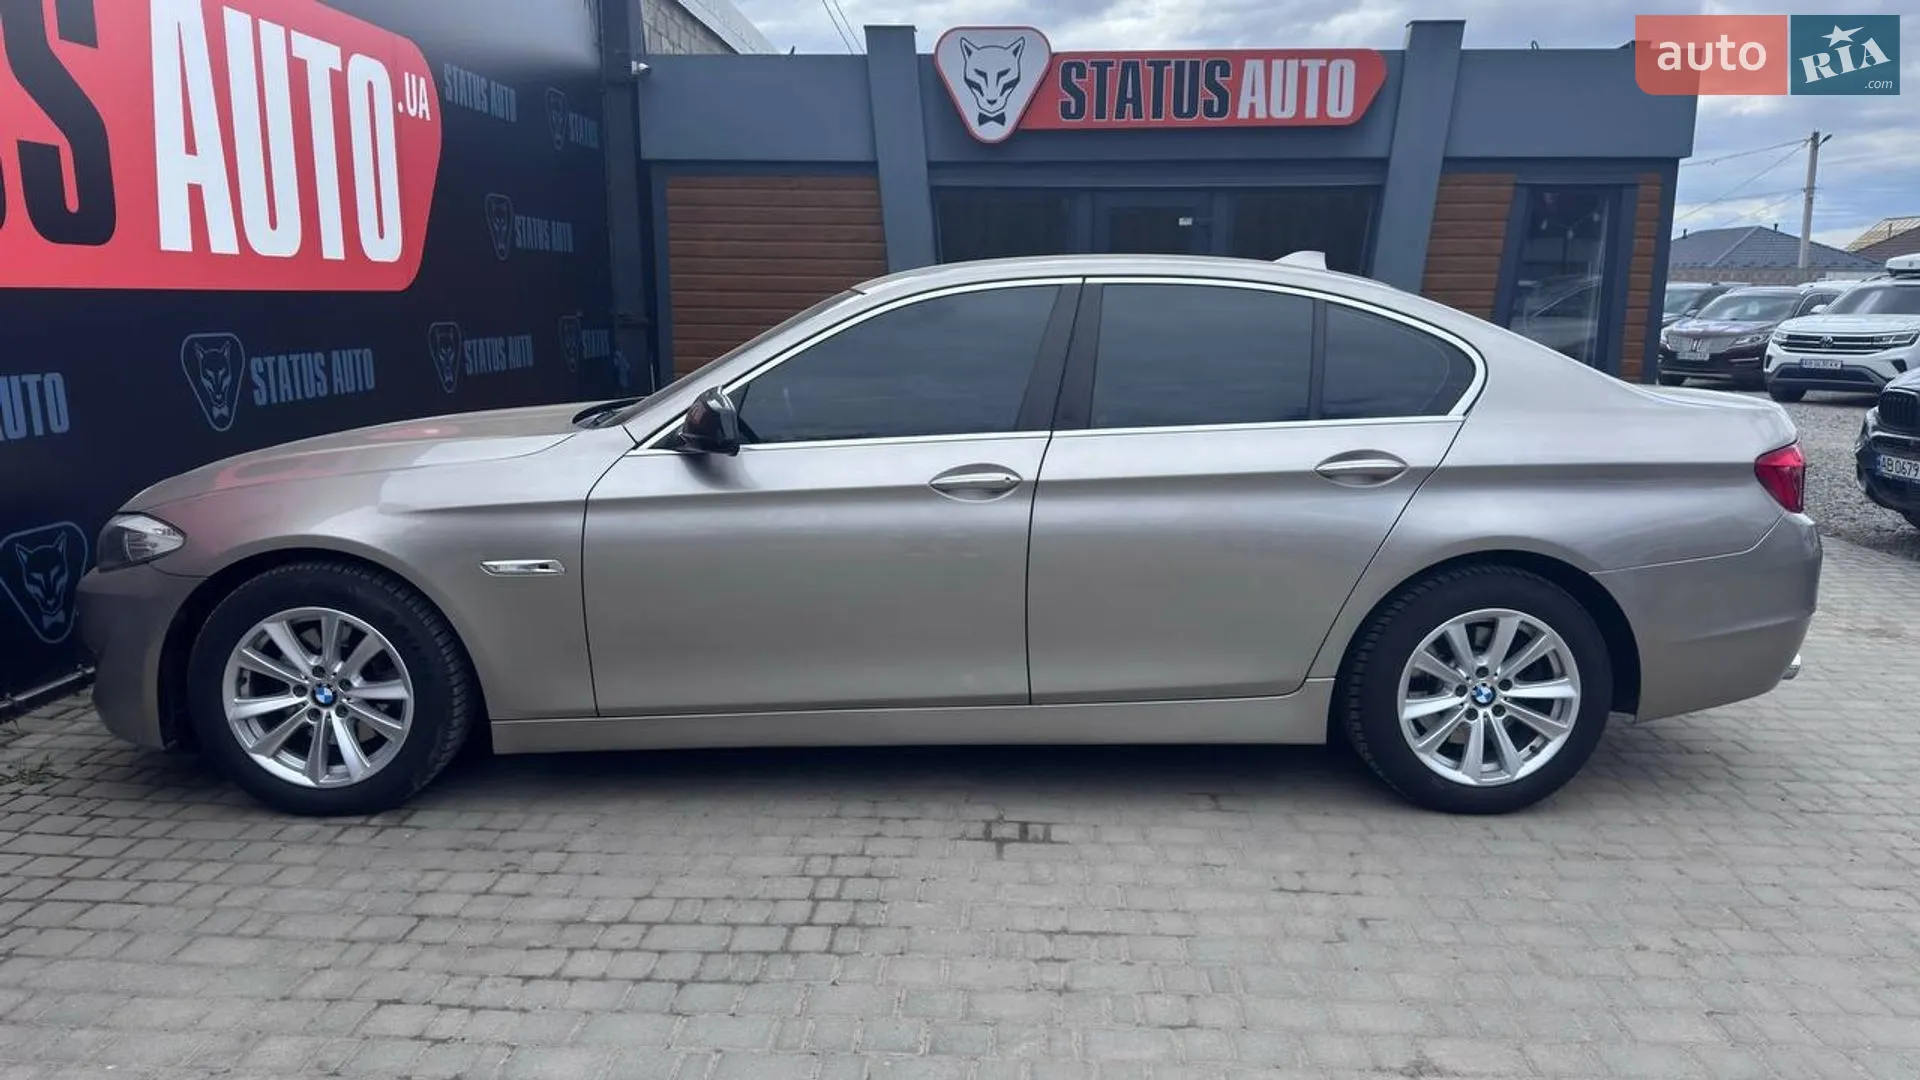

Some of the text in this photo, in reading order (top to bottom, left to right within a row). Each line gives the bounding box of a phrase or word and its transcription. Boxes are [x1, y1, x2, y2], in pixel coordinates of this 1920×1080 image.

[444, 63, 517, 123] STATUS AUTO
[1058, 58, 1356, 122] STATUS AUTO
[514, 214, 574, 253] STATUS AUTO
[250, 348, 376, 407] STATUS AUTO
[463, 334, 534, 377] STATUS AUTO
[0, 372, 71, 443] UTO
